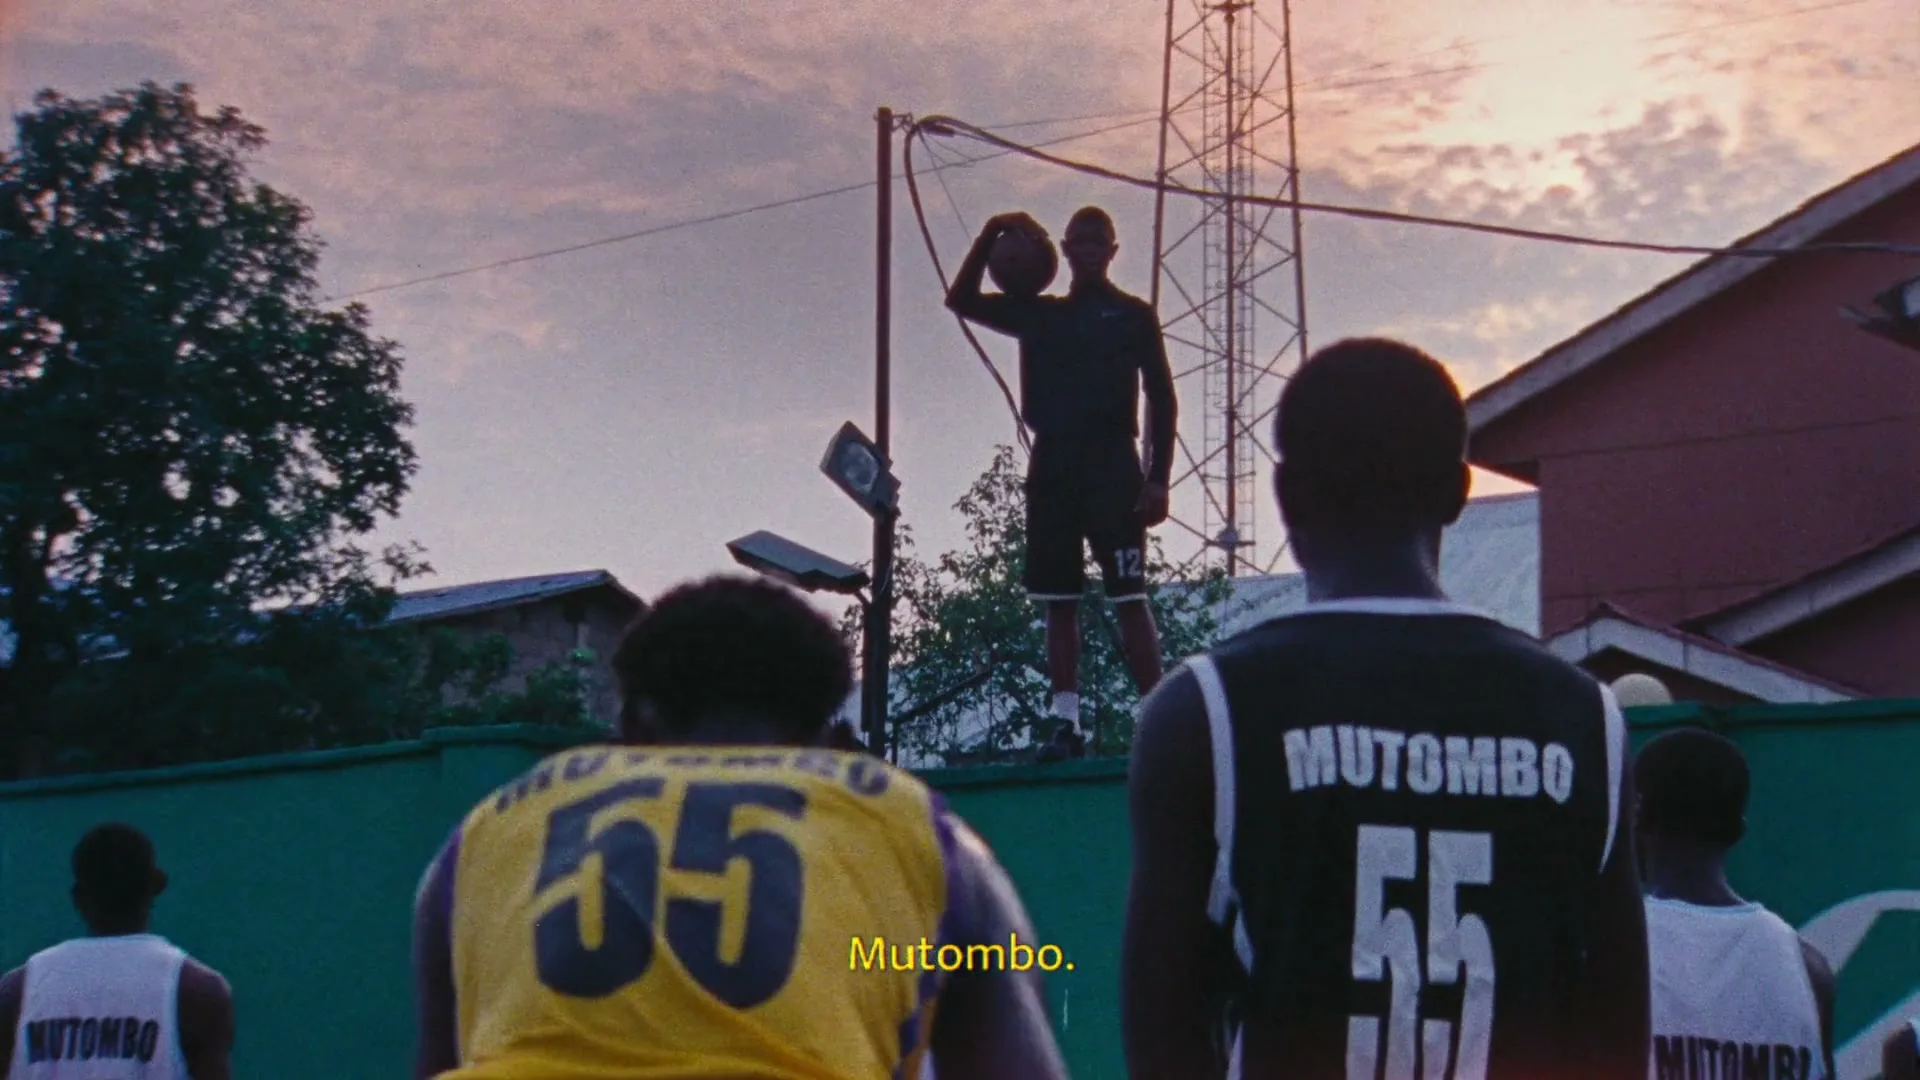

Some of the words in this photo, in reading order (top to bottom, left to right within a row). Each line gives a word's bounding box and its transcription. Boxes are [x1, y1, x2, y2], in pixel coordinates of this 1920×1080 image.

[1283, 725, 1573, 803] MUTOMBO
[533, 778, 808, 1010] 55
[1346, 824, 1495, 1080] 55
[27, 1017, 158, 1063] MUTOMBO
